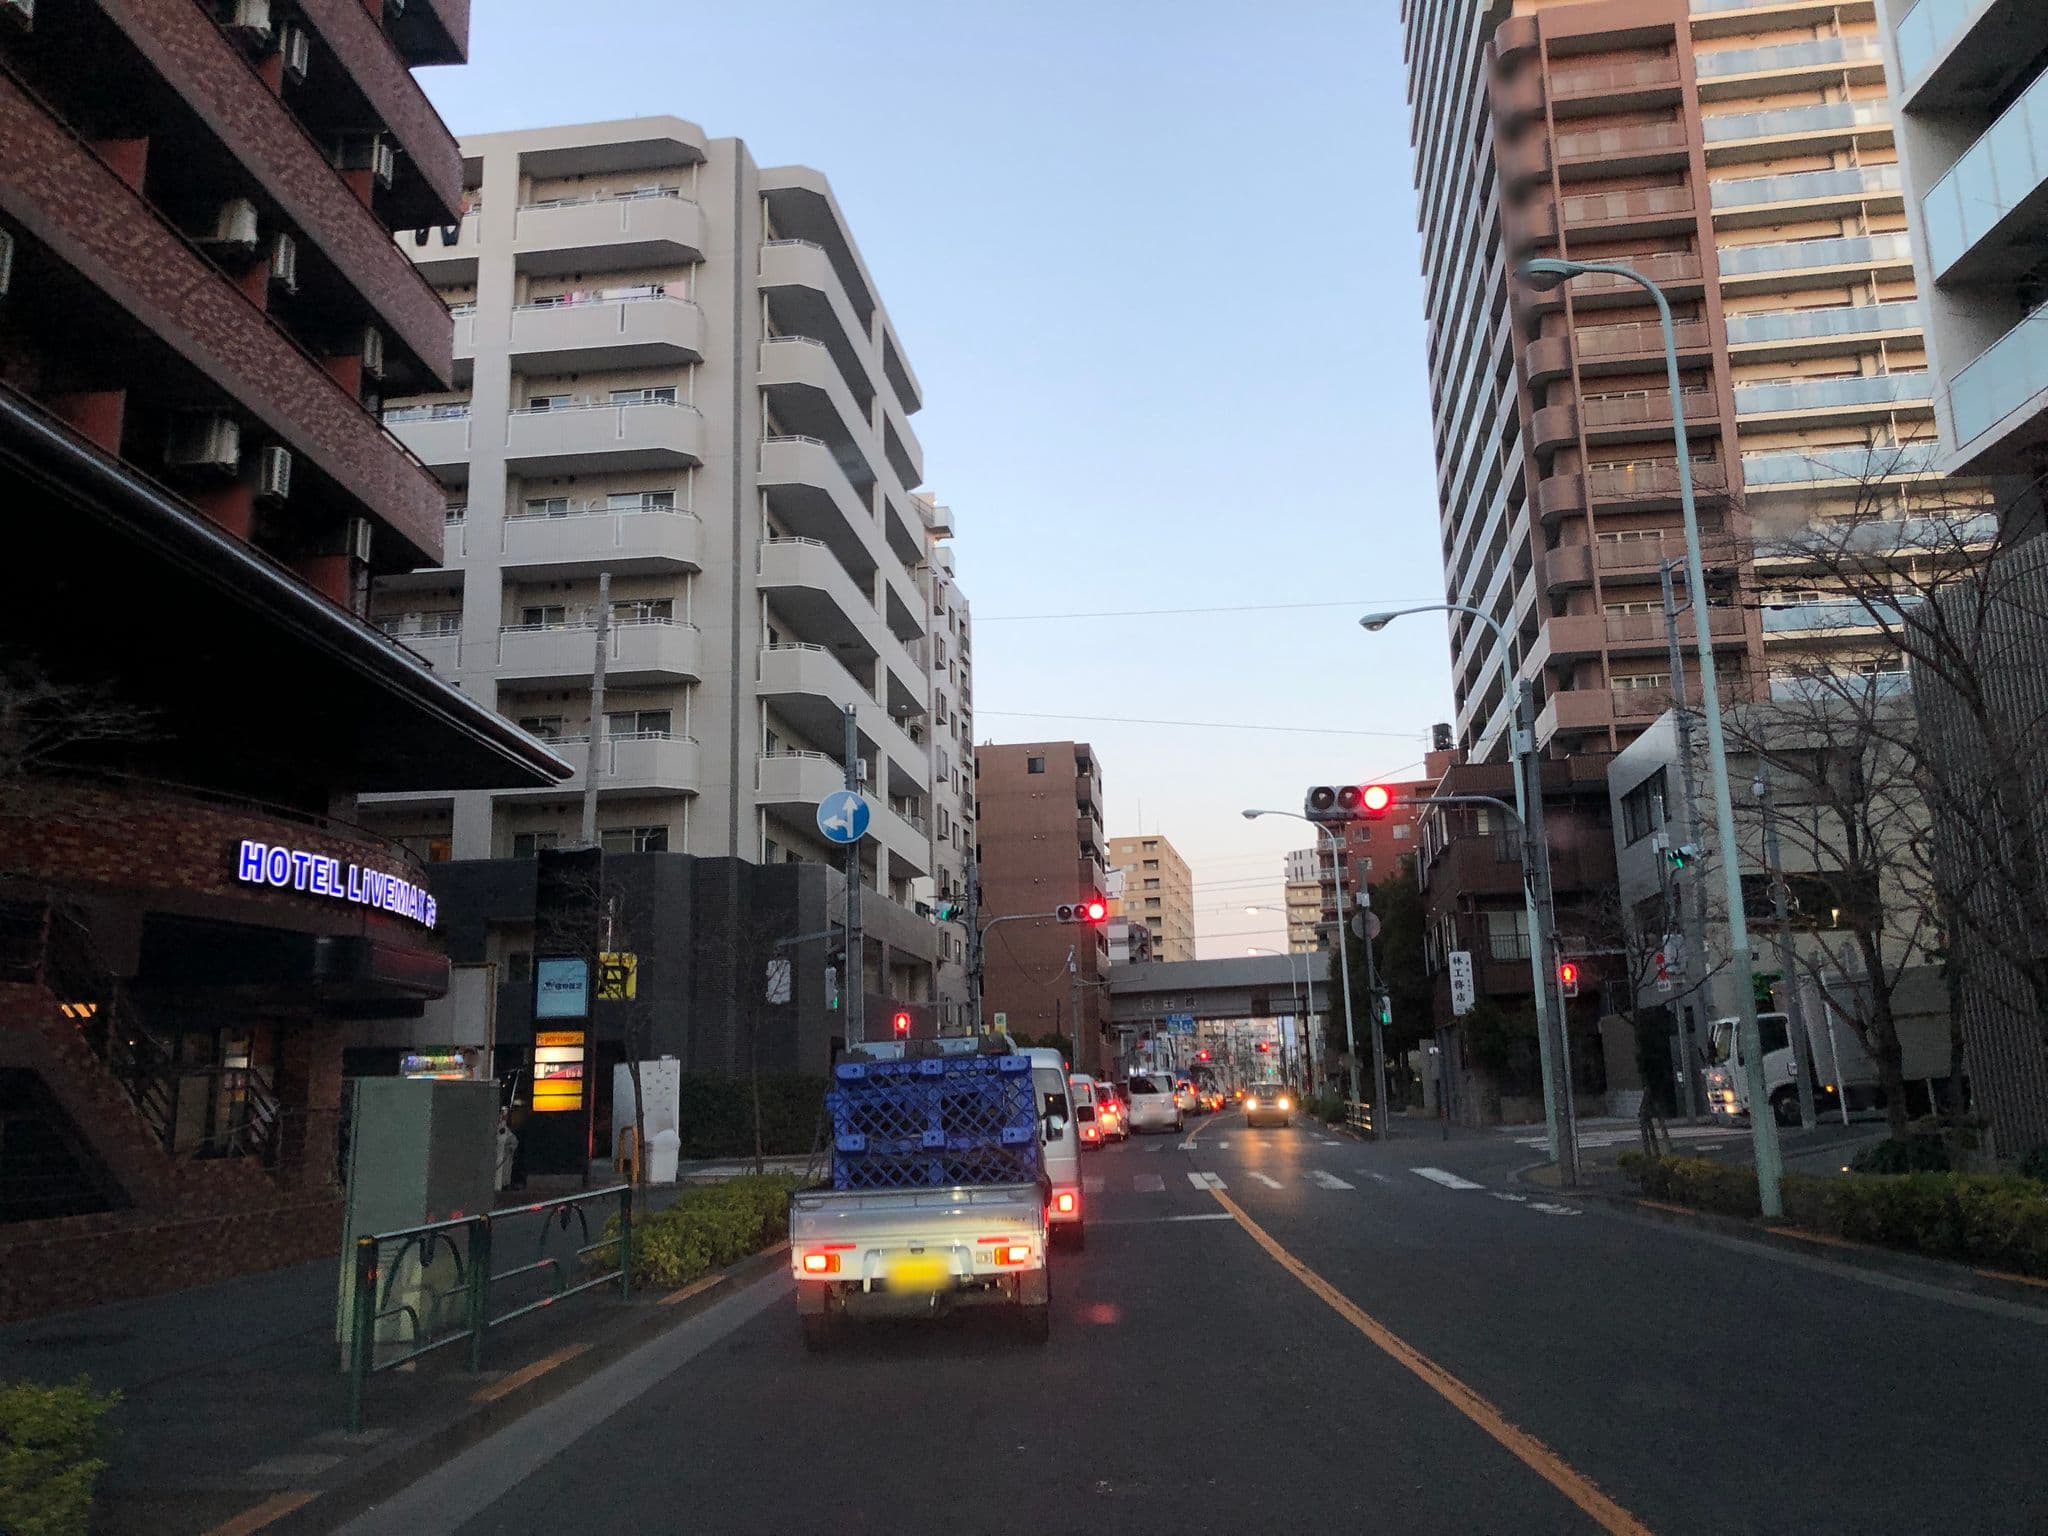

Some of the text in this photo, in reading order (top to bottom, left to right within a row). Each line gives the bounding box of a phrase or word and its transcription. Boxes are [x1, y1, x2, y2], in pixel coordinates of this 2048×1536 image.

[238, 840, 344, 898] HOTEL
[1452, 956, 1466, 1003] 林工務店
